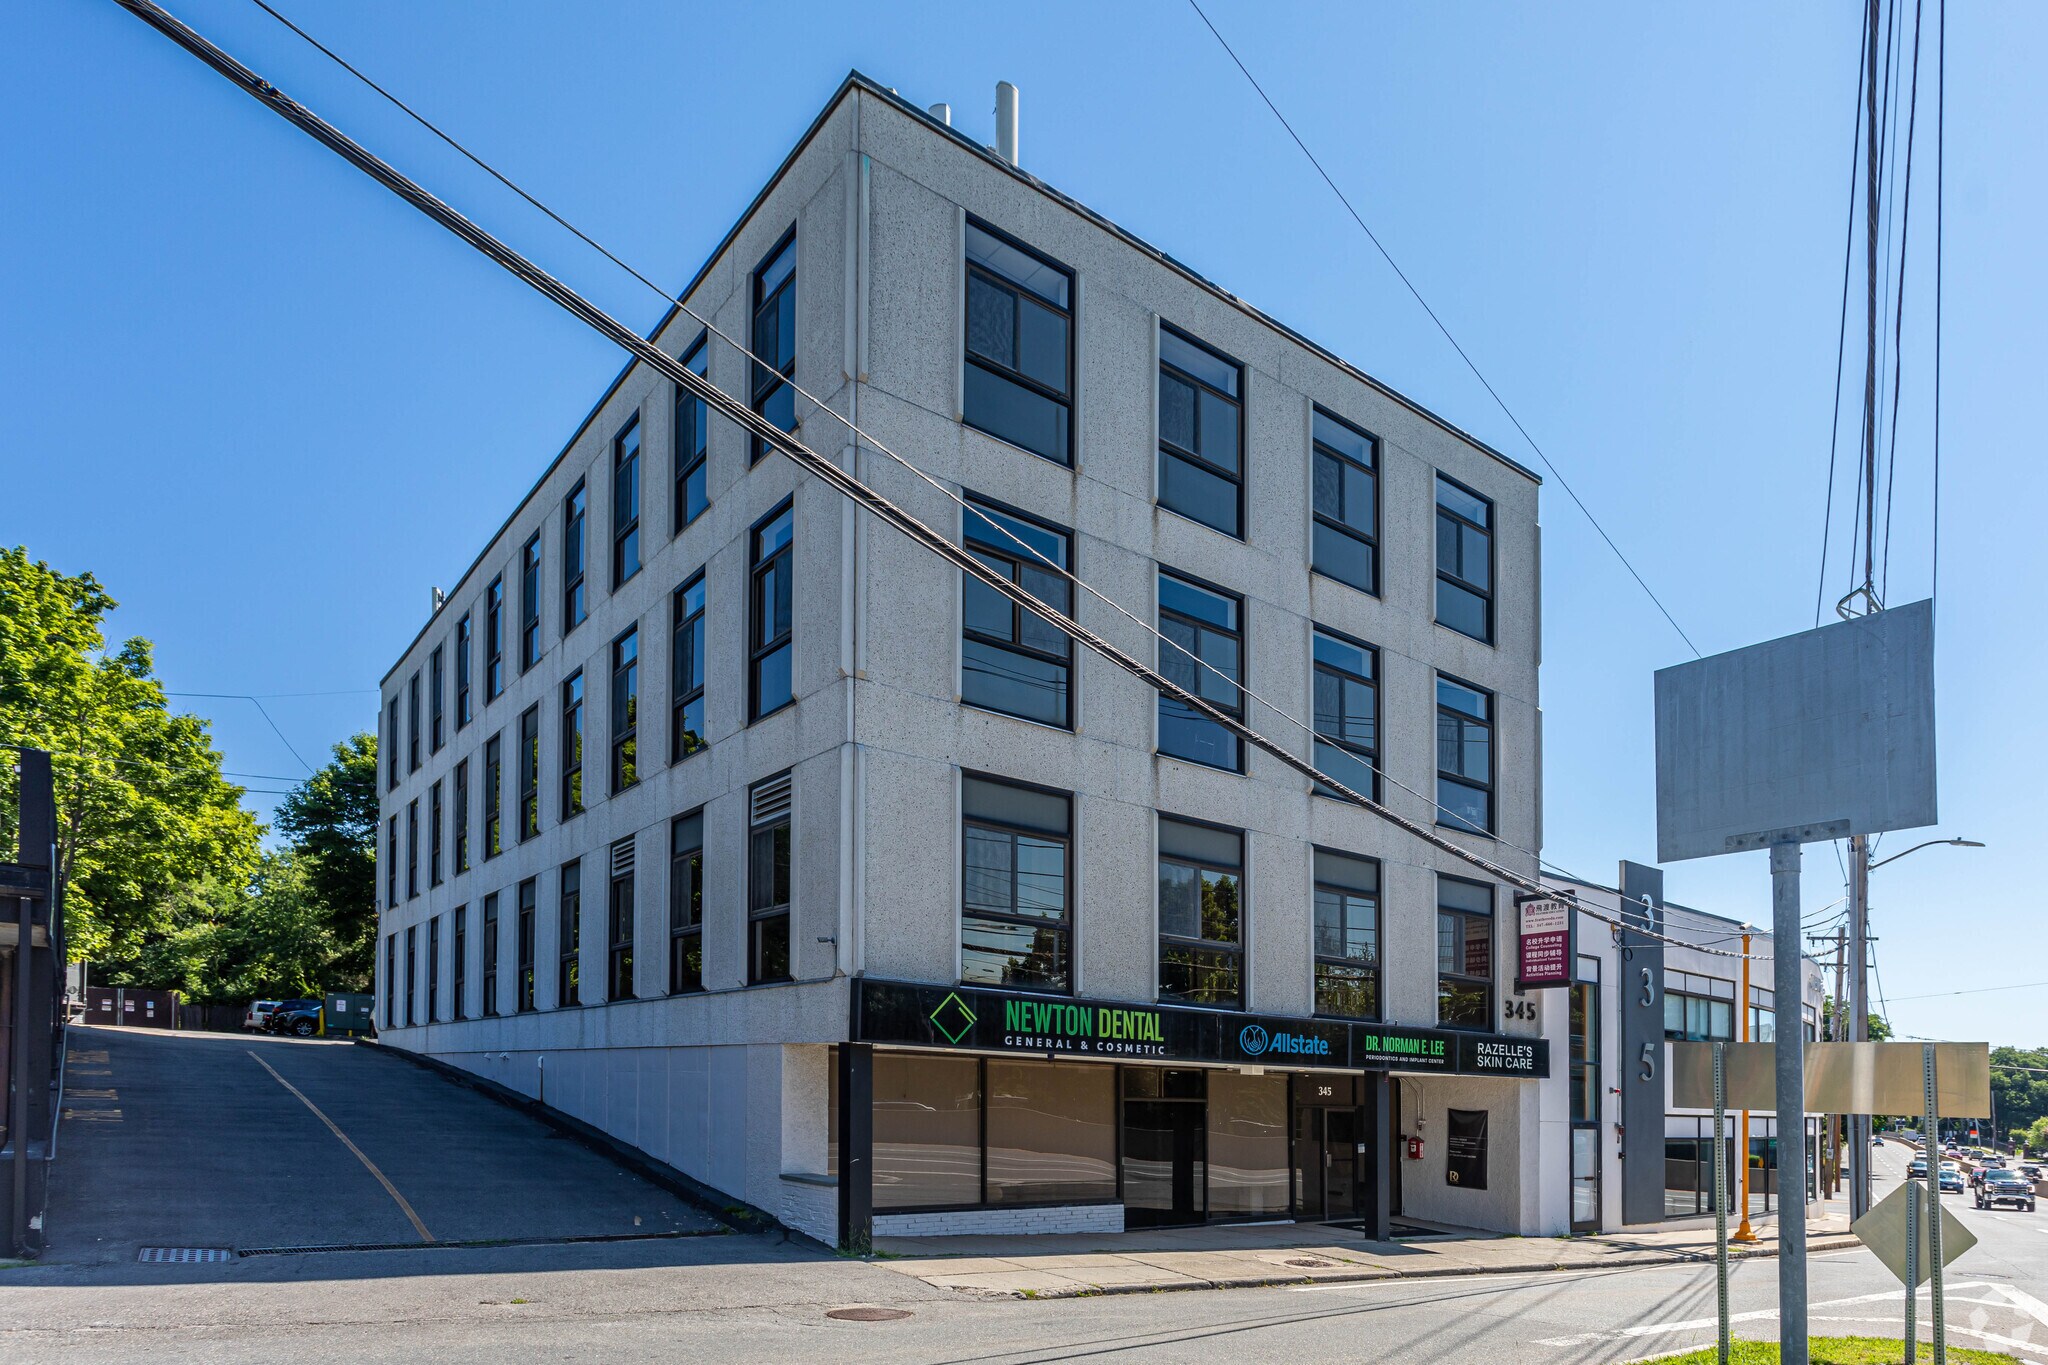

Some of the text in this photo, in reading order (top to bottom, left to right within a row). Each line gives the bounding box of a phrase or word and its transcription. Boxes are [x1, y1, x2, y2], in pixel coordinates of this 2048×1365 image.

[1505, 1000, 1536, 1021] 345
[1006, 1000, 1164, 1042] NEWTON DENTAL
[1004, 1036, 1165, 1055] GENERAL & COSMETIC
[1268, 1032, 1329, 1055] Allstate
[1366, 1034, 1445, 1056] DR. NORMAN E. LEE
[1477, 1042, 1533, 1058] RAZELLE'S
[1365, 1054, 1399, 1062] PERIODONTICS
[1477, 1055, 1533, 1070] SKIN CARE
[1318, 1086, 1332, 1097] 345
